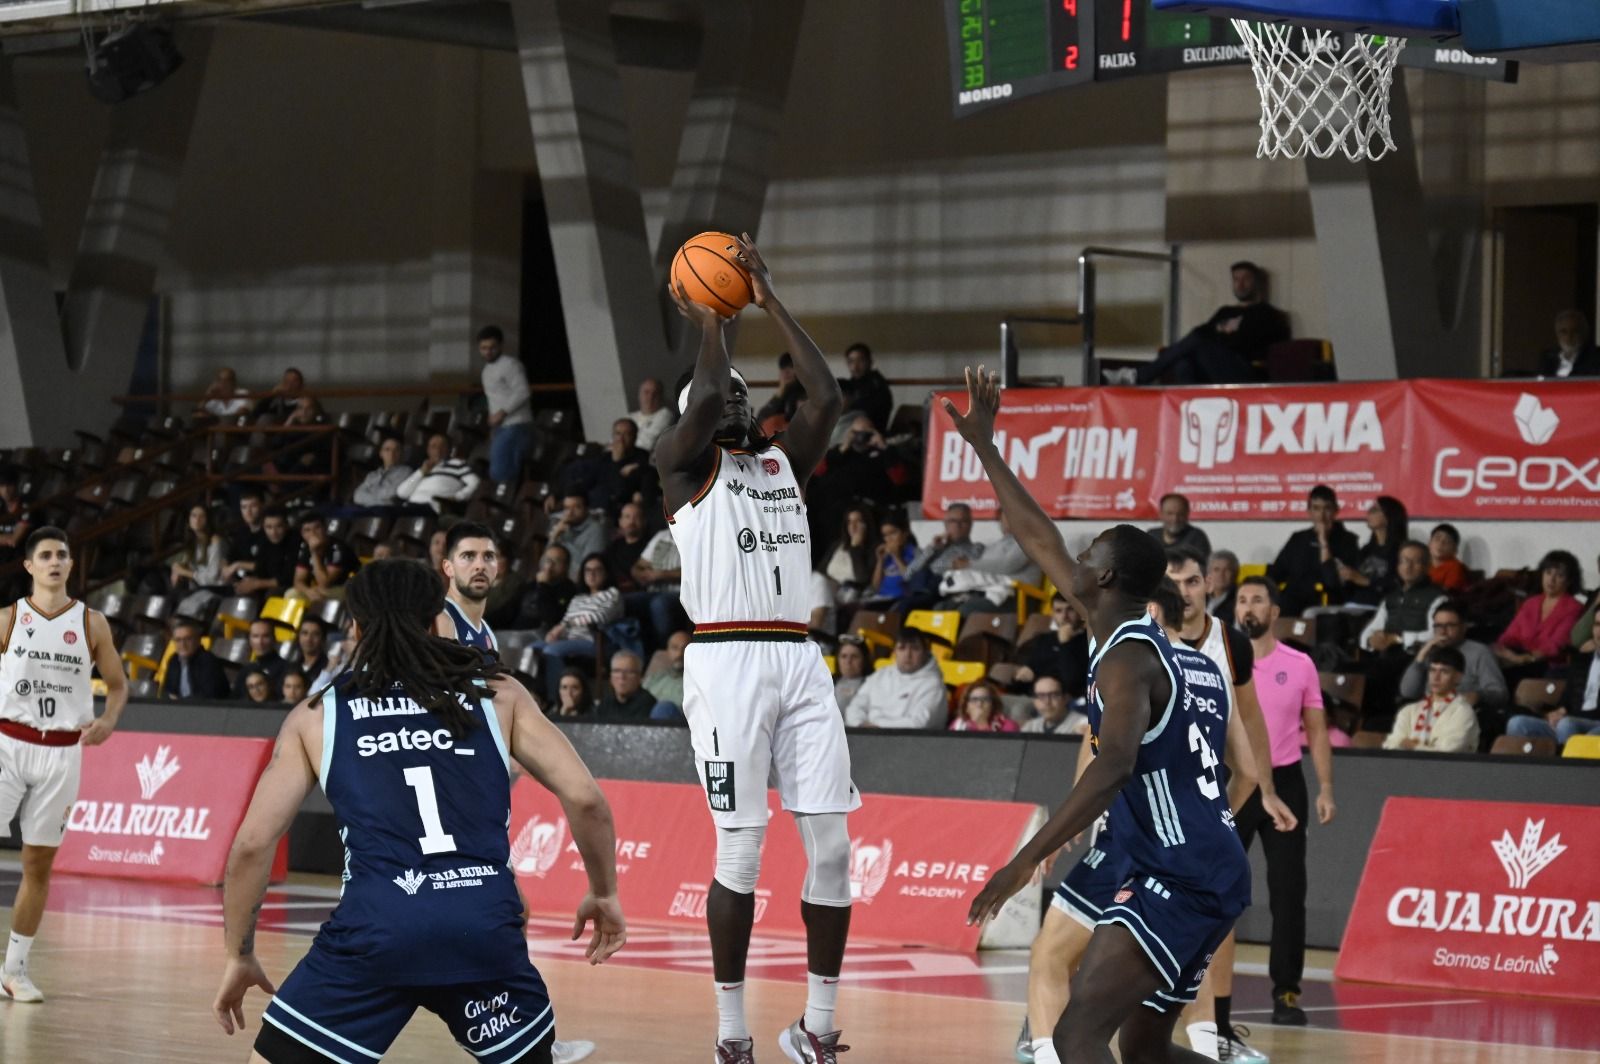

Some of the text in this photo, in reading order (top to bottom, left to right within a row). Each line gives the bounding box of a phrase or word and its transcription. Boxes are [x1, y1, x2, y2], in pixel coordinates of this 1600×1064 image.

[1065, 45, 1078, 69] 2
[1100, 52, 1136, 68] FALTAS
[1183, 45, 1254, 62] EXCLUSIONE
[959, 84, 1012, 104] MONDO
[1245, 401, 1385, 454] IXMA
[1063, 427, 1138, 480] HAM
[1433, 447, 1600, 497] Geox
[774, 566, 782, 595] 1
[28, 650, 83, 665] CAJA RURAL
[38, 697, 56, 718] 10
[347, 691, 449, 720] WILLIA
[713, 727, 719, 756] 1
[67, 800, 210, 840] CAJA RURAL
[403, 766, 457, 855] 1
[428, 865, 499, 881] CAJA RURAL
[432, 879, 483, 890] DE ASTURIAS
[894, 861, 989, 884] ASPIRE
[900, 885, 966, 899] ACADEMY
[1387, 887, 1482, 932] CAJA
[1433, 947, 1534, 974] Somos León
[464, 991, 509, 1019] Grupo
[466, 1006, 522, 1044] CARAC
